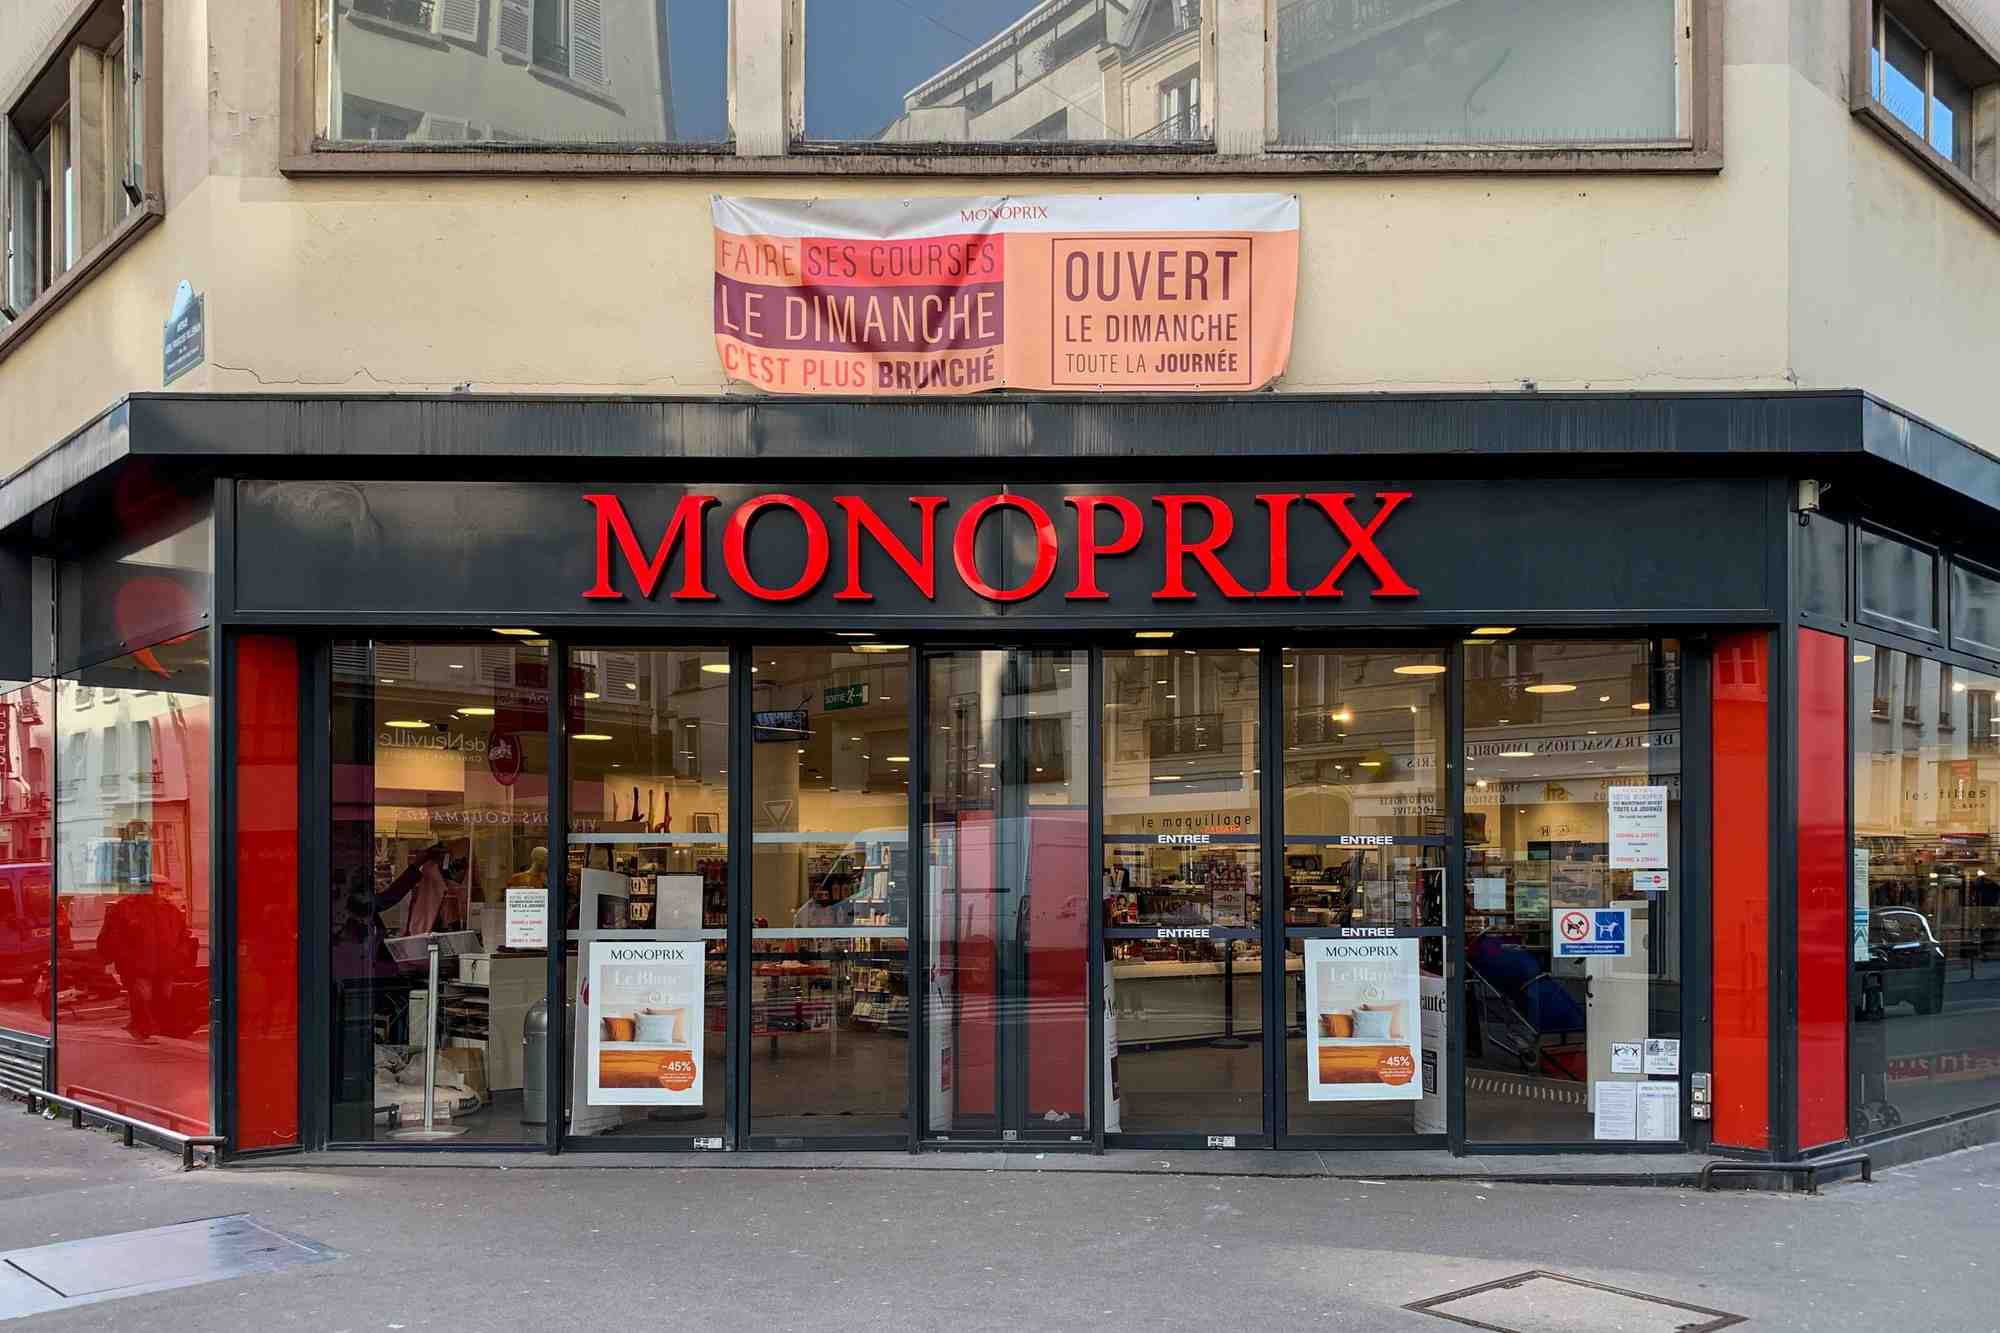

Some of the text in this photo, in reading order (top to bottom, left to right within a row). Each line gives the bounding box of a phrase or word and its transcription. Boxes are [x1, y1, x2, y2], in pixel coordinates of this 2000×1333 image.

[960, 206, 1048, 223] MONOPRIX
[720, 239, 996, 278] FAIRE SES COURSES
[1065, 250, 1239, 302] OUVERT
[720, 284, 997, 344] LE DIMANCHE
[1065, 313, 1239, 343] LE DIMANCHE
[724, 343, 996, 389] C'EST PLUS BRUNCHÉ
[1065, 349, 1239, 374] TOUTE LA JOURNÉE
[582, 492, 1420, 601] MONOPRIX
[1142, 813, 1252, 829] le maquillage
[1157, 834, 1210, 844] ENTREE
[1340, 836, 1394, 845] ENTREE
[1157, 928, 1210, 938] ENTREE
[1341, 927, 1395, 937] ENTREE
[610, 949, 685, 960] MONOPRIX
[1325, 945, 1399, 957] MONOPRIX
[662, 1061, 692, 1072] -45%
[1380, 1056, 1410, 1067] -45%
